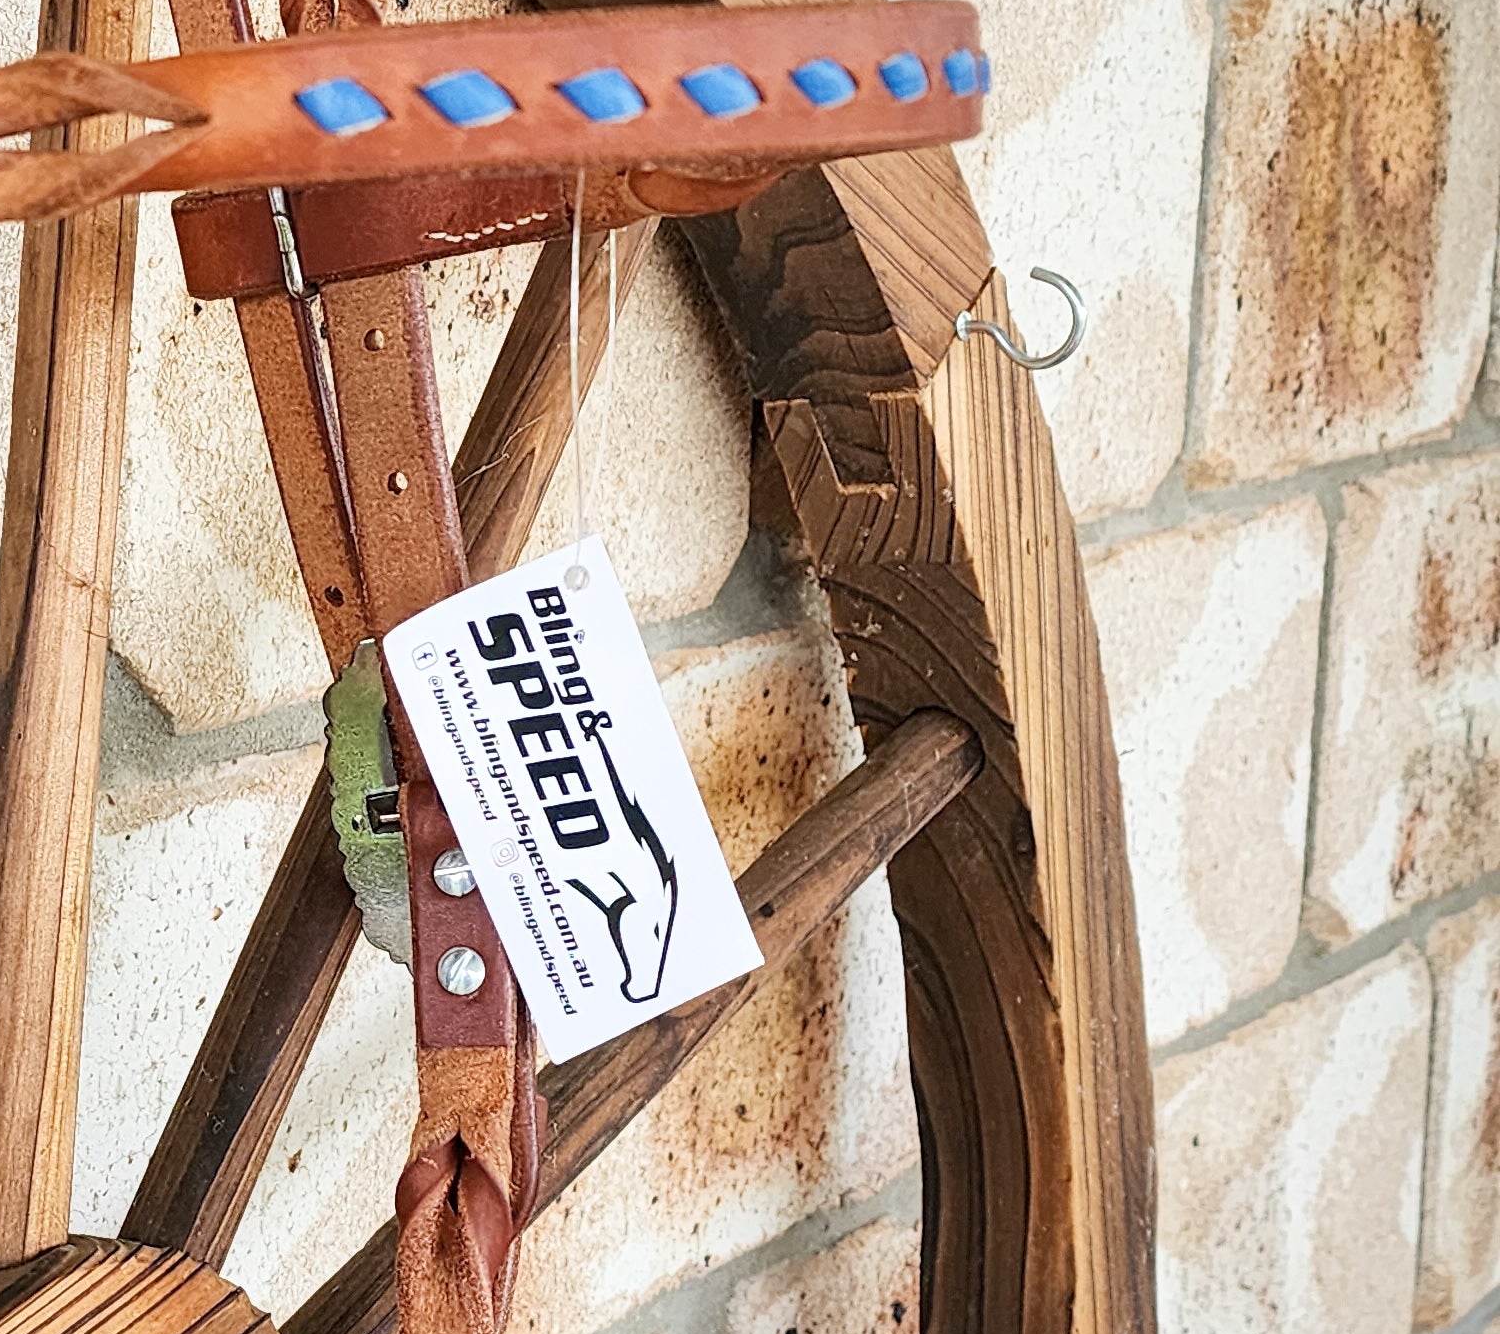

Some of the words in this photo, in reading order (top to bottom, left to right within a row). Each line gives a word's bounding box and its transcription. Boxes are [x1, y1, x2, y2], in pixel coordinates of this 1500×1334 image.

[428, 675, 498, 821] @blingandspeed
[509, 872, 578, 1016] @blingandspeed
[445, 648, 595, 989] www.blingandspeed.com.au
[467, 612, 610, 850] SPEED
